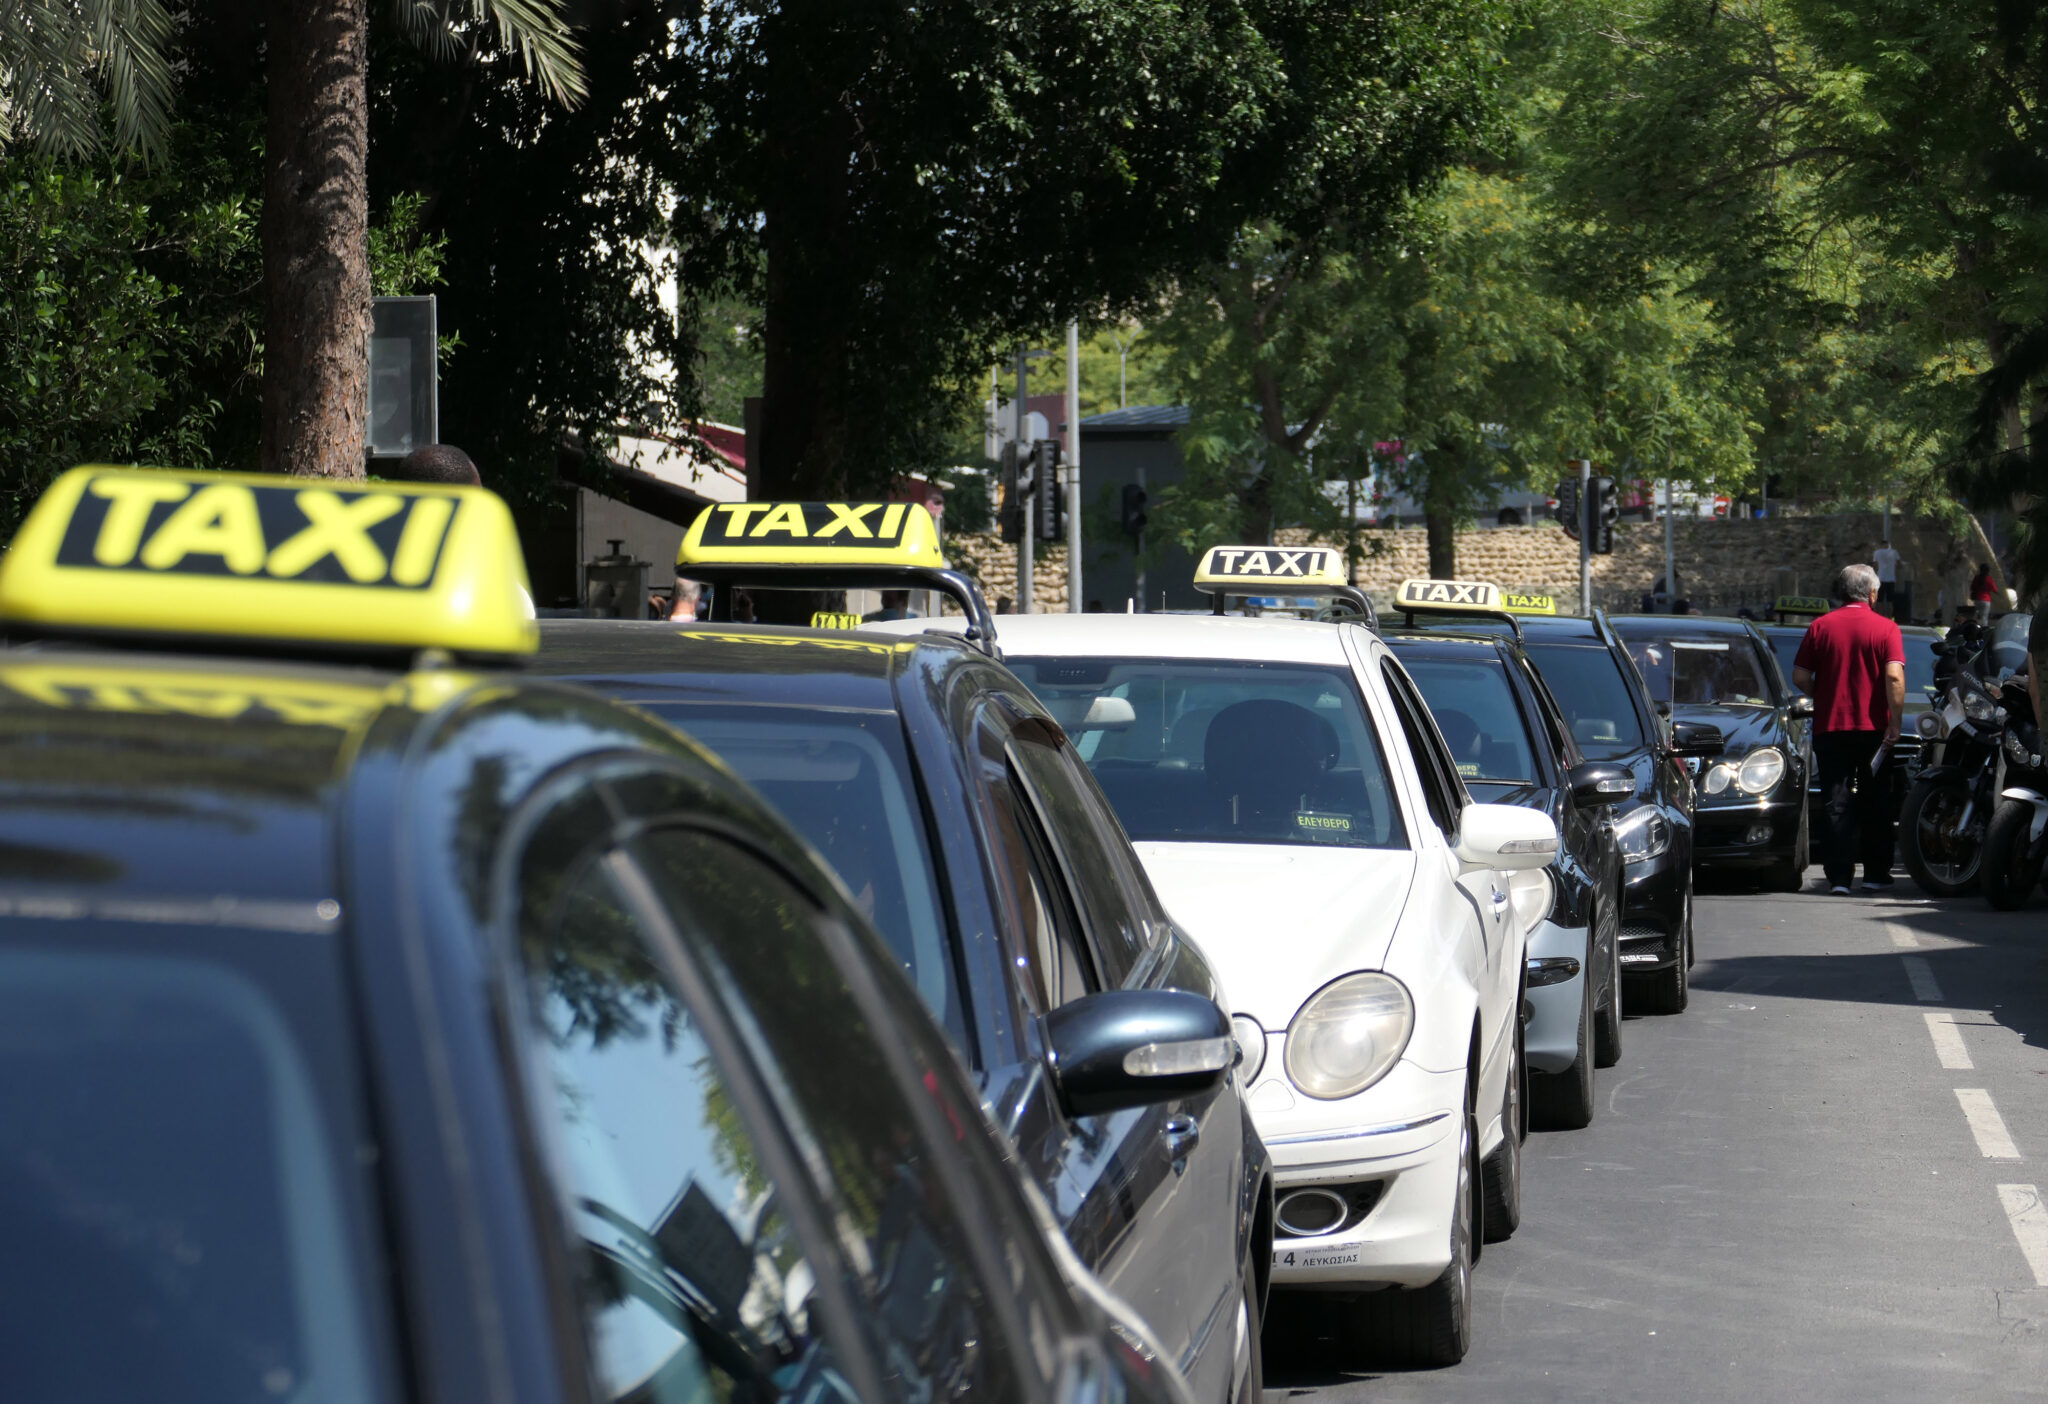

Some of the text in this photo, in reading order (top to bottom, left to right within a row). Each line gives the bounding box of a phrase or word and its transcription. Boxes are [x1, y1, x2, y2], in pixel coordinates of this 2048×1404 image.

[717, 503, 906, 538] TAXI
[90, 475, 456, 587] TAXI
[1218, 551, 1321, 575] TAXI
[1411, 582, 1486, 604] TAXI
[1508, 594, 1548, 607] TAXI
[1783, 597, 1822, 609] TAXI
[818, 615, 855, 631] TAXI
[1298, 816, 1350, 830] ΕΛΕΥΘΕΡΟ
[1283, 1251, 1296, 1266] 4
[1302, 1254, 1358, 1267] ΛΕΥΚΩΣΙΑΣ
